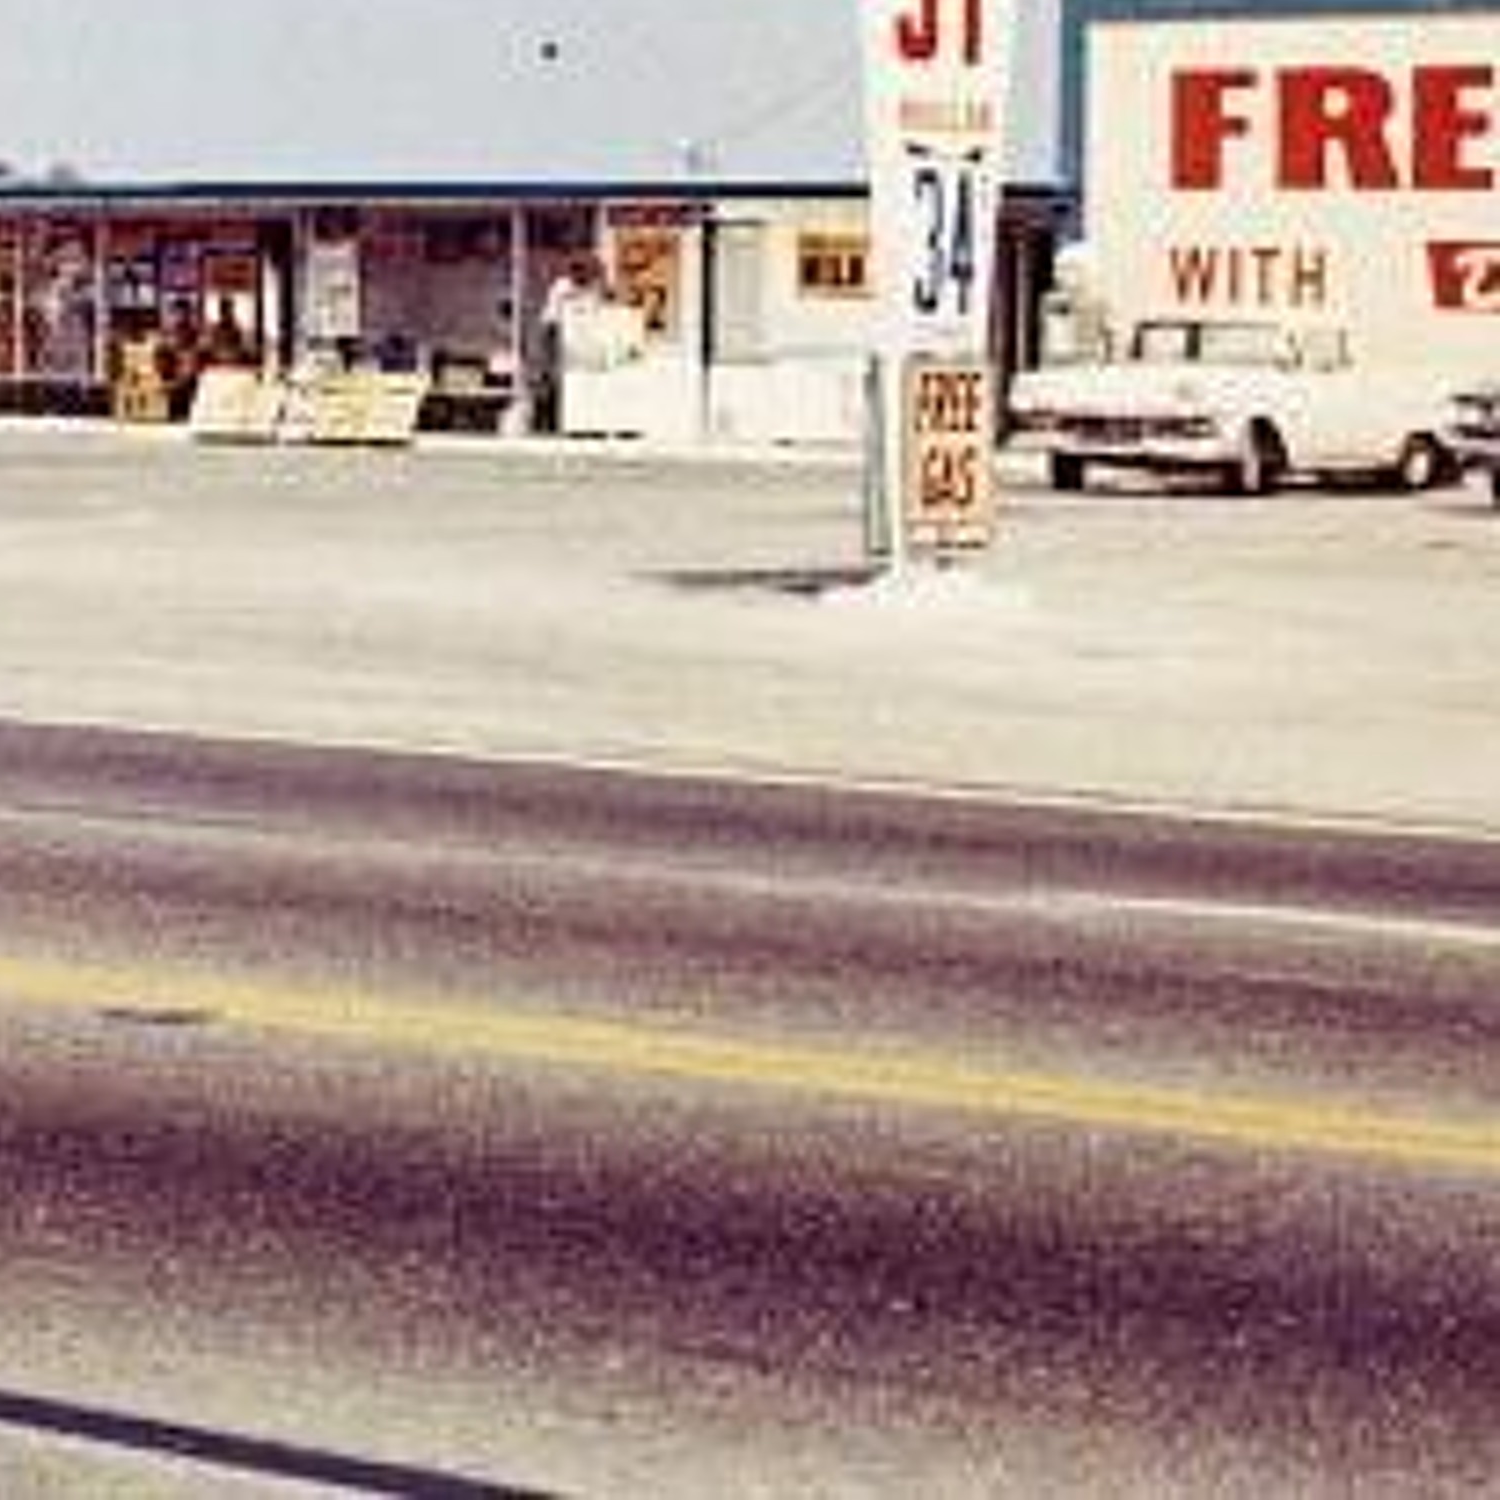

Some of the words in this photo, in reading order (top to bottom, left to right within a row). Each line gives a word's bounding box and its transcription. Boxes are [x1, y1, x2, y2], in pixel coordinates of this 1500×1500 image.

[1171, 64, 1494, 190] FRE
[1170, 246, 1327, 305] WITH
[915, 372, 983, 433] FREE
[920, 445, 977, 507] GAS
